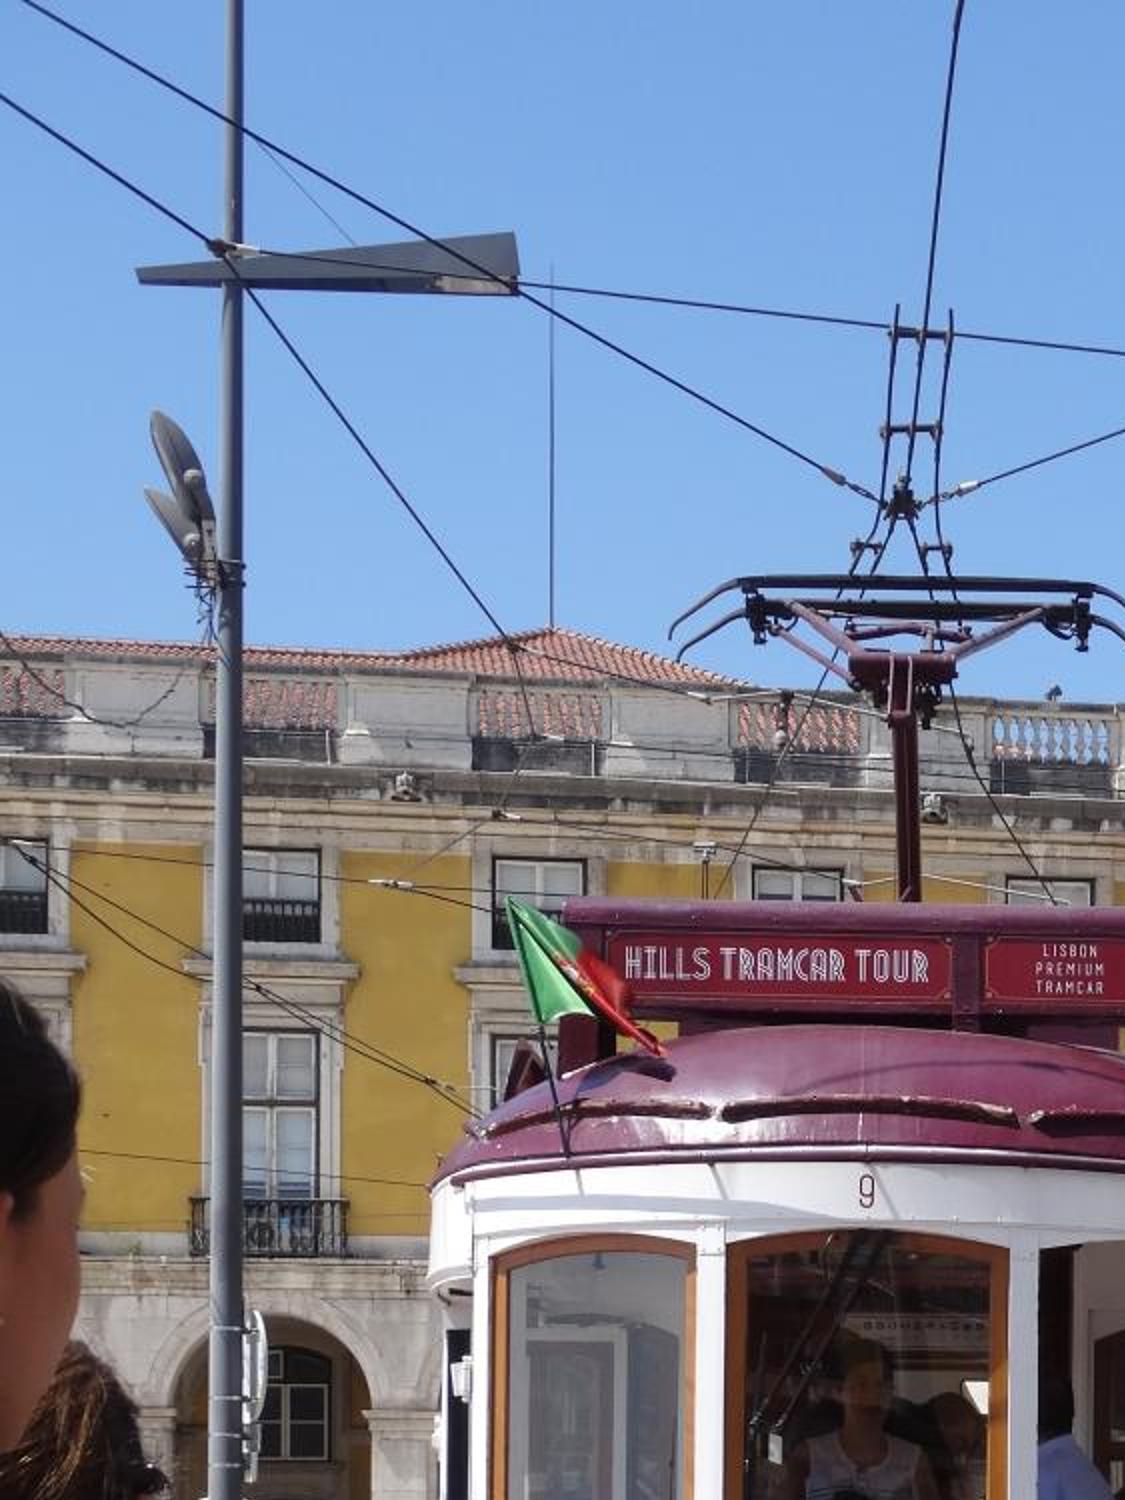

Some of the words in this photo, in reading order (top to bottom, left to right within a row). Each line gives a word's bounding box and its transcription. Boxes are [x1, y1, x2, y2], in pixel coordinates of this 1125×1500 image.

[1042, 943, 1098, 958] LISBON
[625, 945, 711, 981] HILLS
[719, 947, 846, 983] TRAMCAR
[855, 948, 929, 984] TOUR
[1035, 961, 1105, 977] PREMIUM
[1036, 979, 1105, 996] TRAMCAR
[859, 1173, 875, 1209] 9
